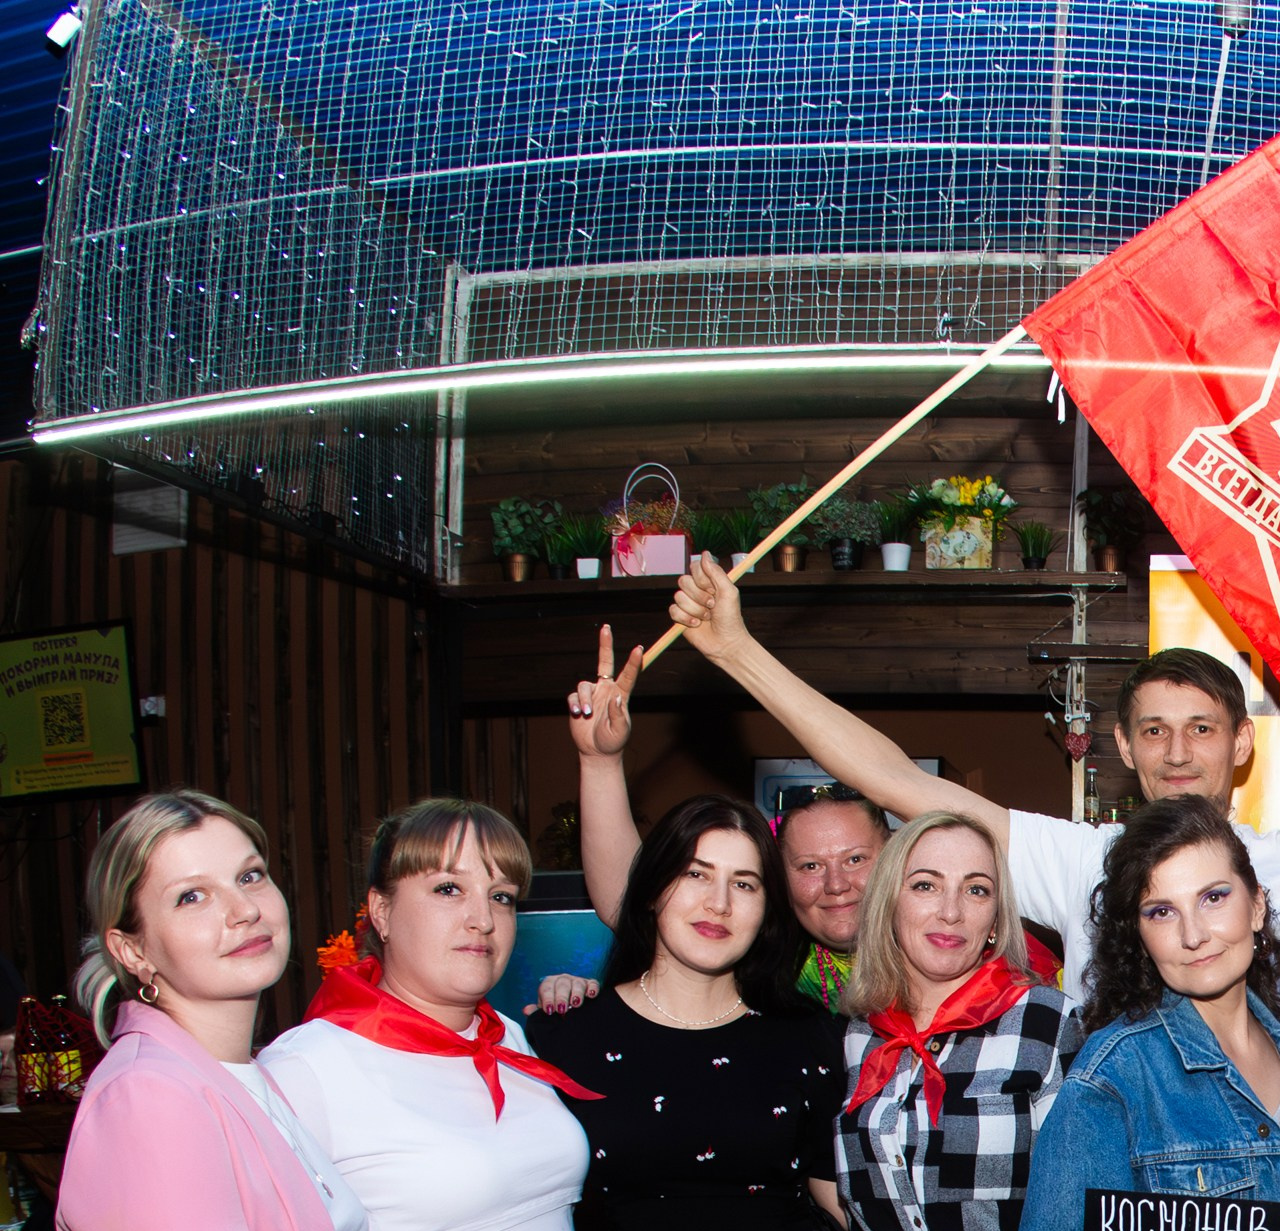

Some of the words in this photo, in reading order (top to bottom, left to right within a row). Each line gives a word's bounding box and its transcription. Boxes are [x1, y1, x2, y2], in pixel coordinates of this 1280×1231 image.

[5, 684, 15, 698] И
[16, 666, 77, 693] ВЫИГРАЙ
[80, 667, 119, 685] ПРИЗ!
